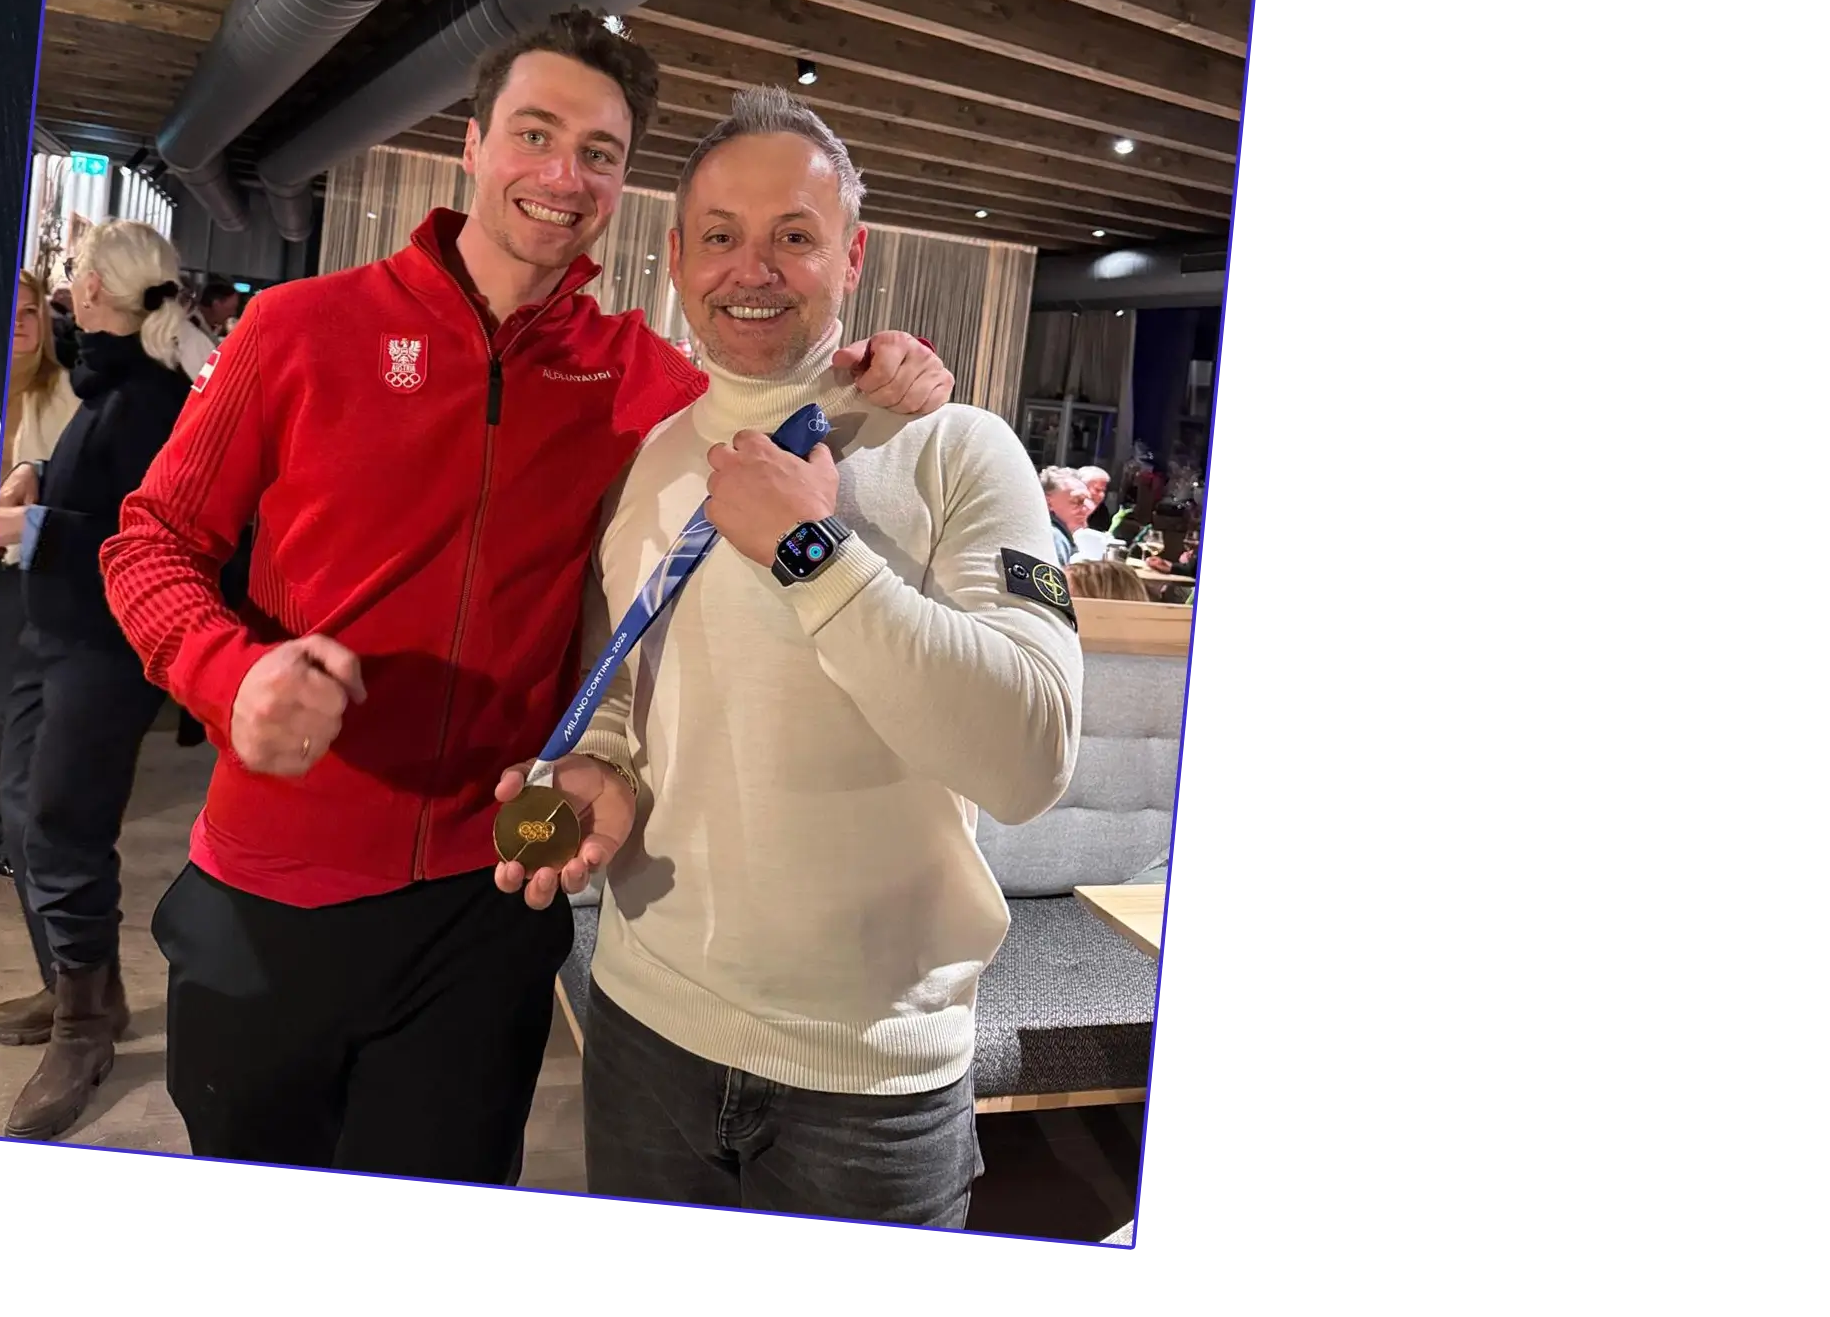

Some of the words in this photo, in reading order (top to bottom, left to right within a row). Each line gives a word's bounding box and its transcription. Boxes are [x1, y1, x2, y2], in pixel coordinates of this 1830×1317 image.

[541, 368, 612, 383] ALPHATAURI
[564, 697, 589, 742] MILANO
[586, 655, 615, 697] CORTINA
[612, 632, 628, 654] 2026
